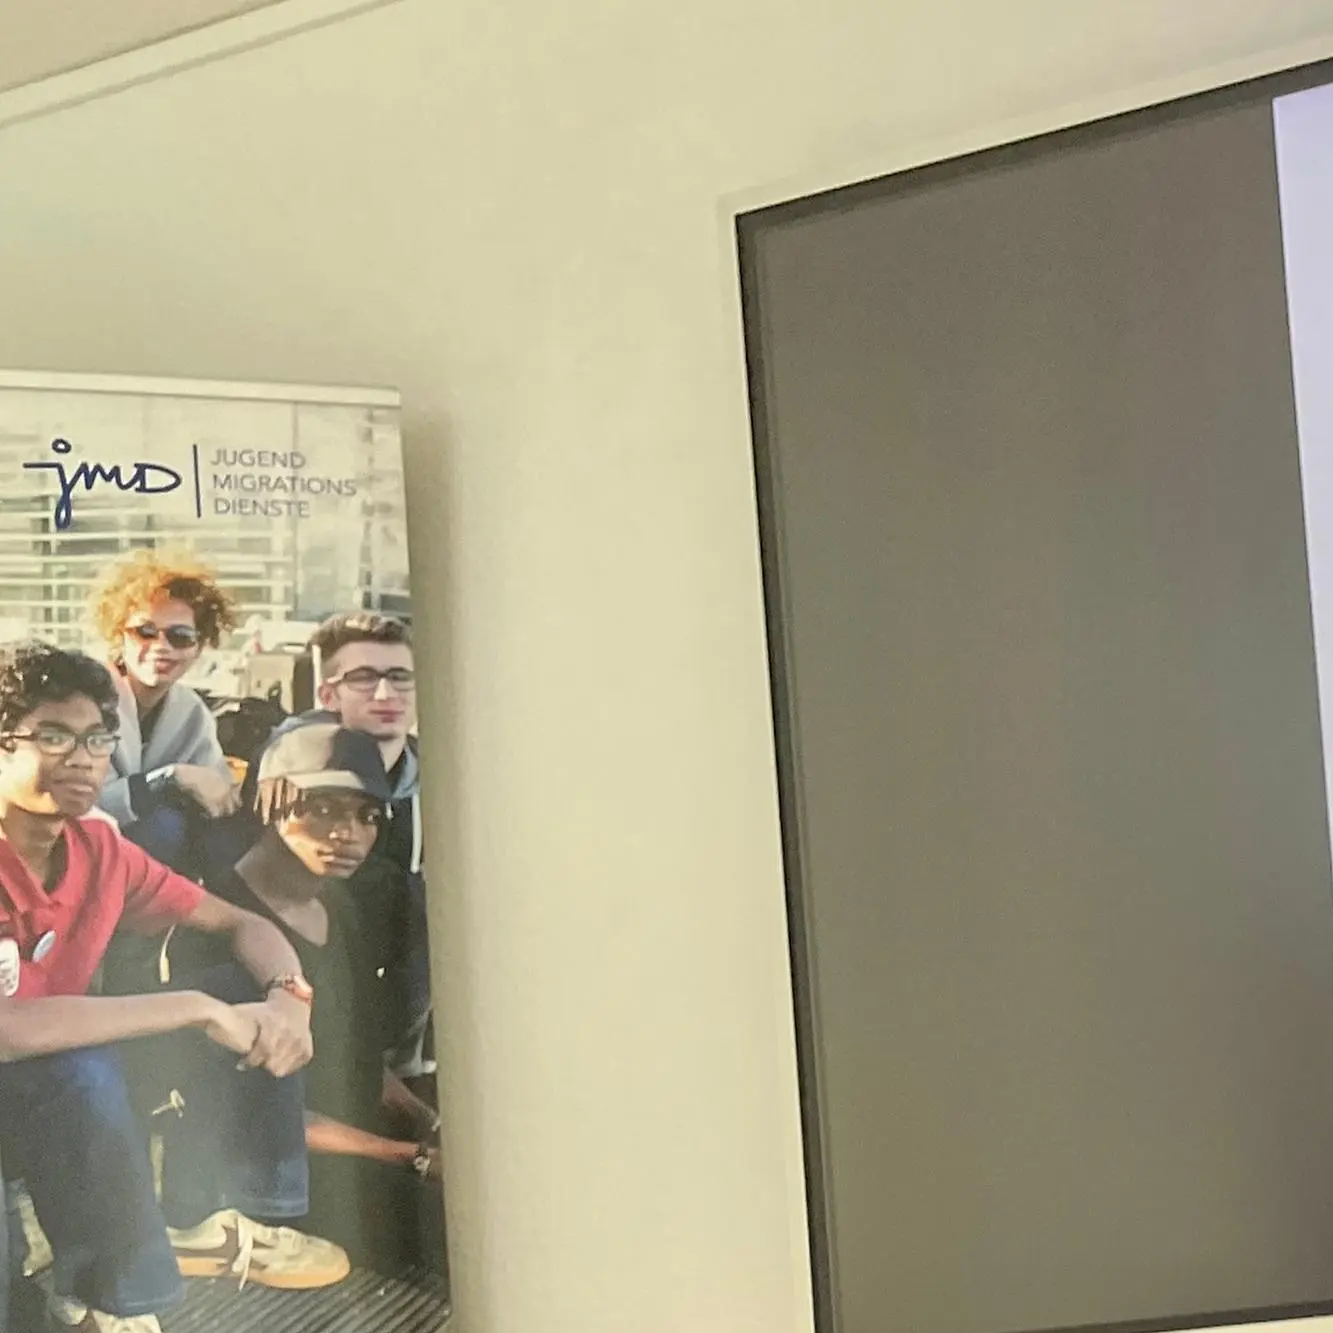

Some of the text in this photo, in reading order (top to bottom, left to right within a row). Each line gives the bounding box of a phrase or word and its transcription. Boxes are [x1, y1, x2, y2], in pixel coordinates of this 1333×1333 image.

[210, 448, 307, 470] JUGEND
[212, 474, 357, 496] MIGRATIONS
[214, 498, 311, 518] DIENSTE
